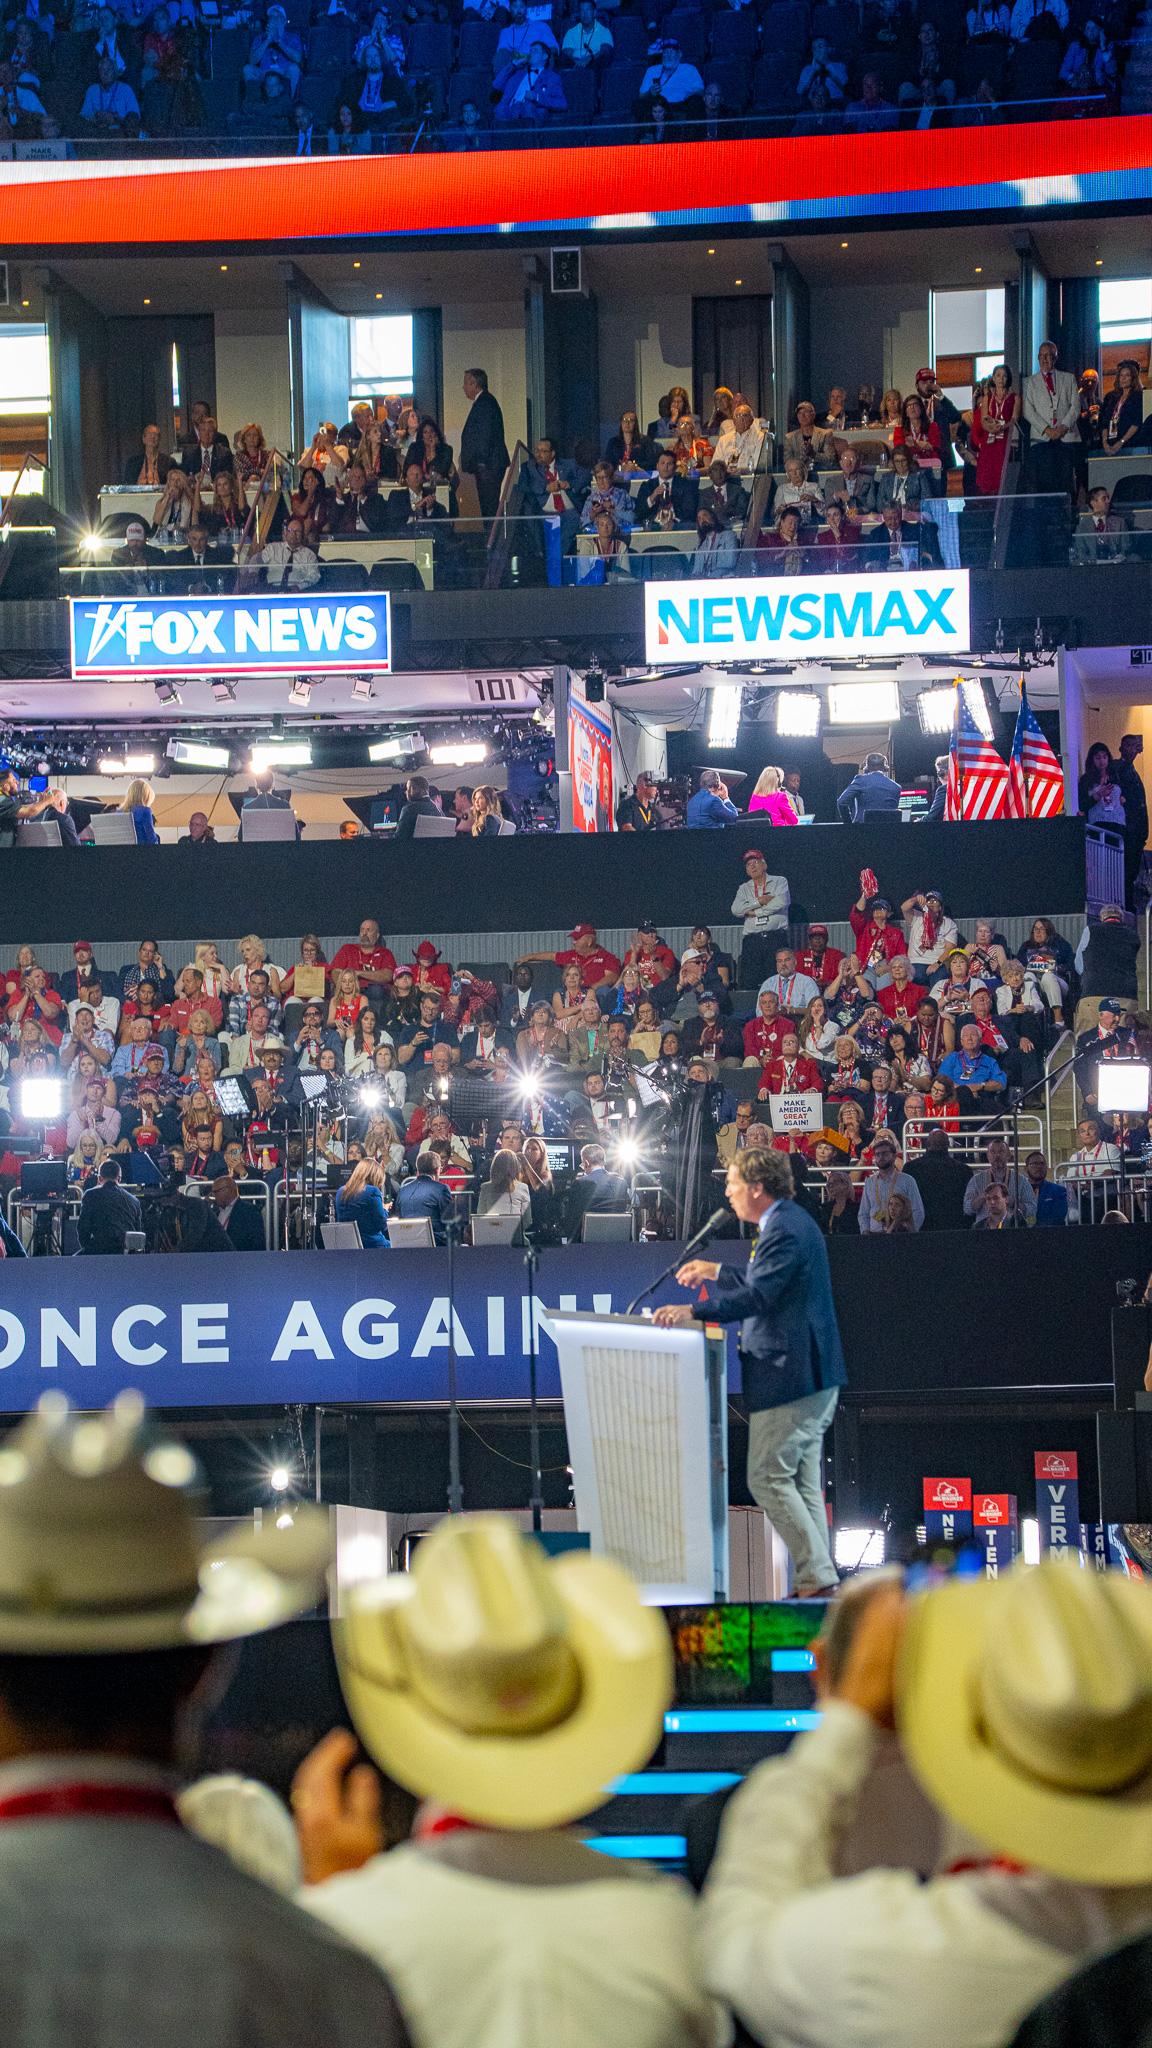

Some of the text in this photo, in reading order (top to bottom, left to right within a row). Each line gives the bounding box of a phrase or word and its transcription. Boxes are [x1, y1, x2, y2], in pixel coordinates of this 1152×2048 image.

[125, 605, 378, 656] FOX NEWS
[658, 588, 957, 645] NEWSMAX
[475, 679, 516, 701] 101
[985, 1529, 998, 1581] TEN
